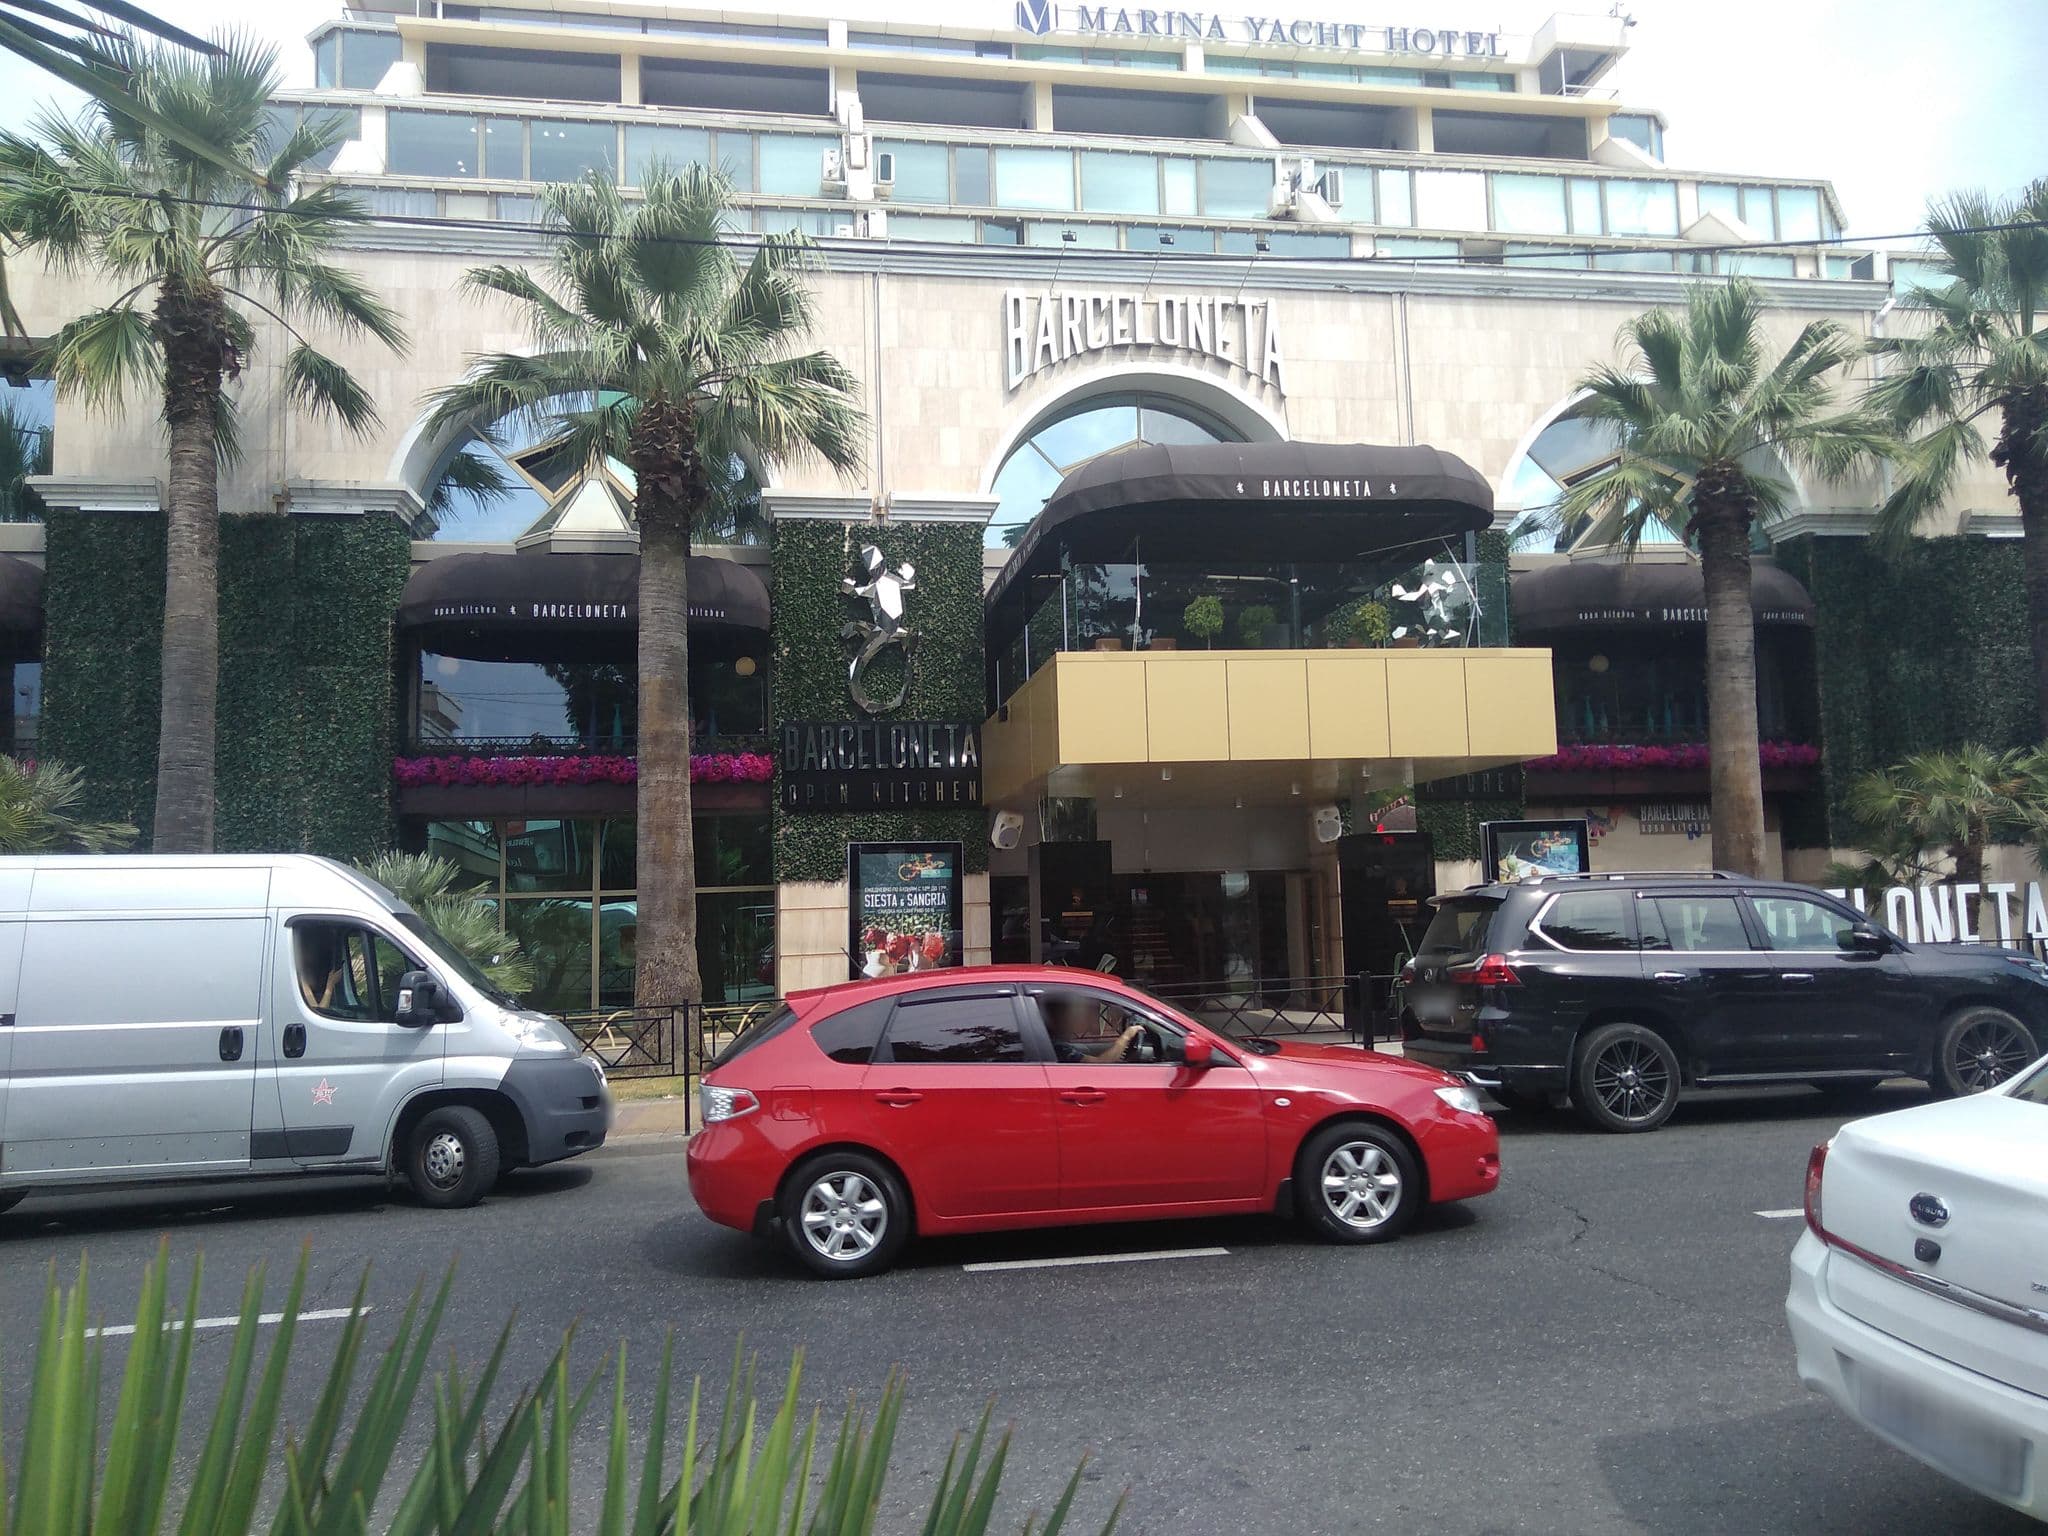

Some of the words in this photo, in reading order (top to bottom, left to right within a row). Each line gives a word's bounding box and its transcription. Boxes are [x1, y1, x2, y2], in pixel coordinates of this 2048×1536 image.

[1078, 5, 1227, 43] MARINA
[1245, 16, 1366, 48] YACHT
[1384, 26, 1508, 58] HOTEL
[1005, 287, 1286, 398] BARCELONETA
[1262, 479, 1372, 498] BARCELONETA
[532, 603, 627, 618] BARCELONETA
[784, 724, 978, 771] BARCELONETA
[864, 893, 898, 908] SIESTA
[906, 892, 947, 907] SANGRIA
